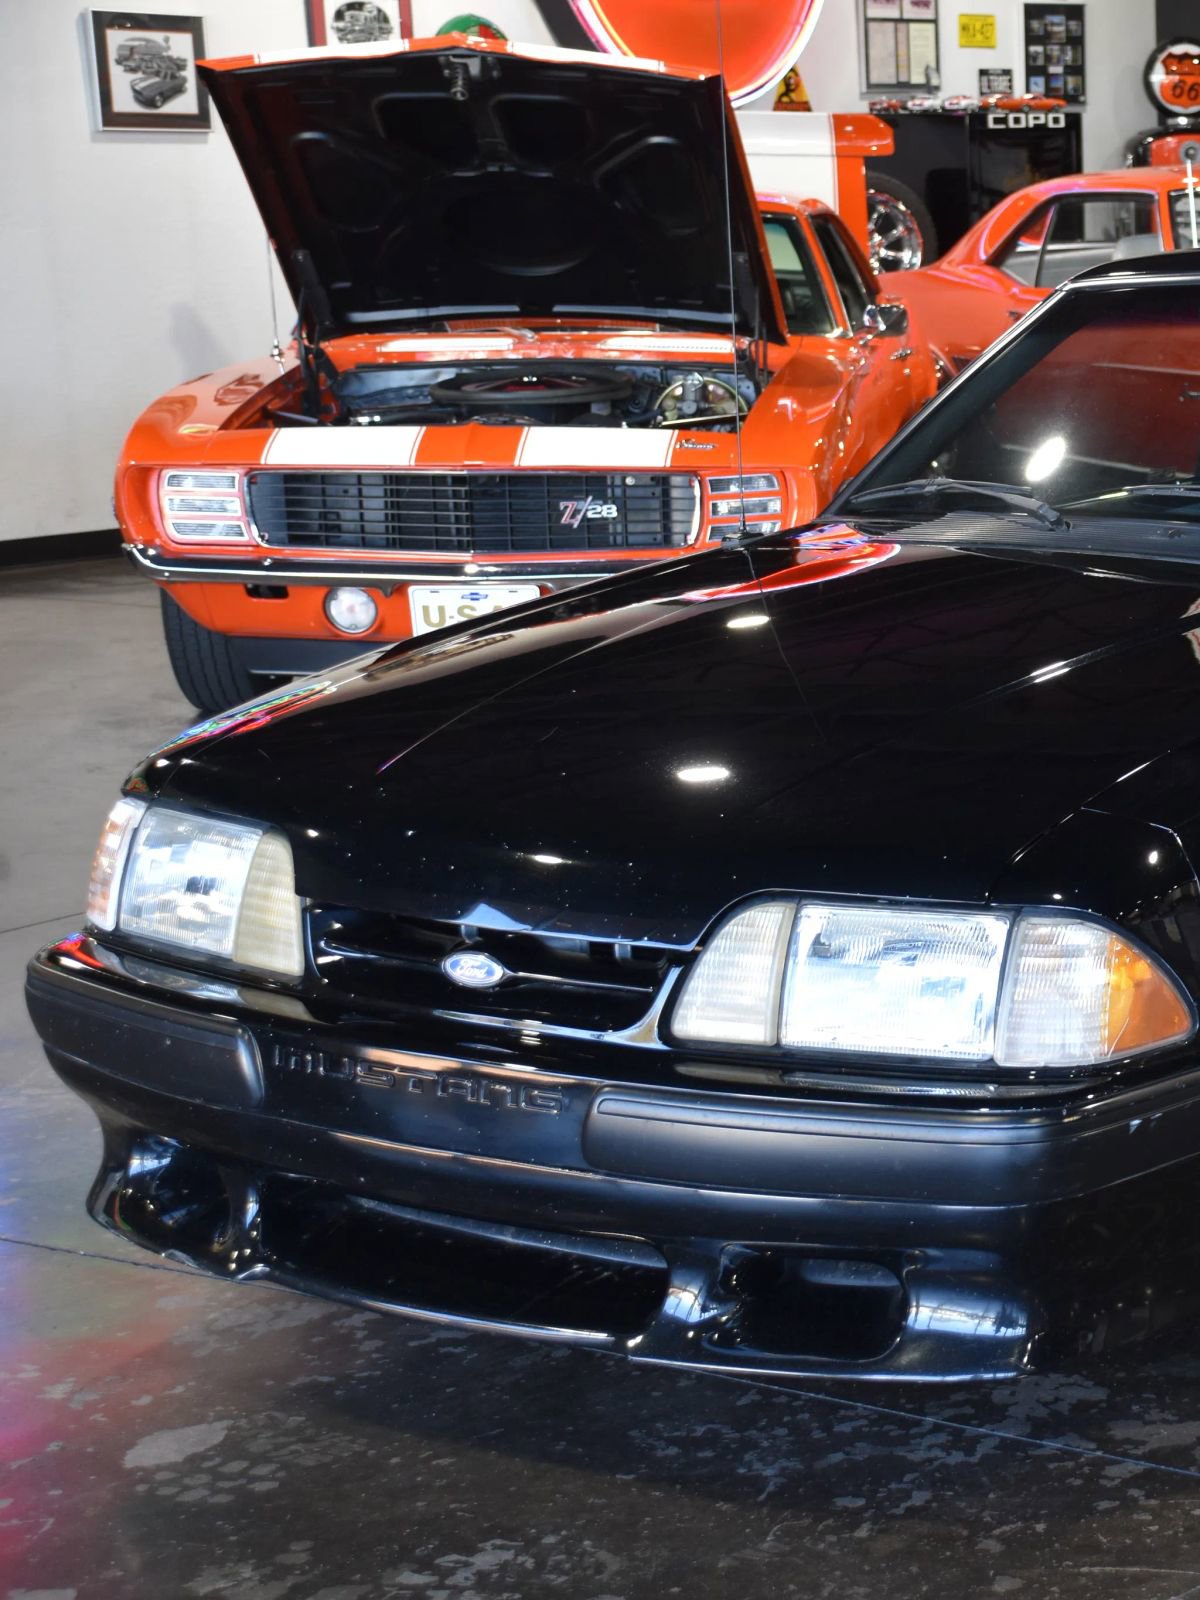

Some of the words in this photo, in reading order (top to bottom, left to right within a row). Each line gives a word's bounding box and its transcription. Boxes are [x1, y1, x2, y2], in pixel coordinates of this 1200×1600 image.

[988, 113, 1066, 129] COPO
[560, 496, 618, 528] Z/28
[456, 957, 490, 979] Ford
[273, 1044, 564, 1115] MUSTANG
